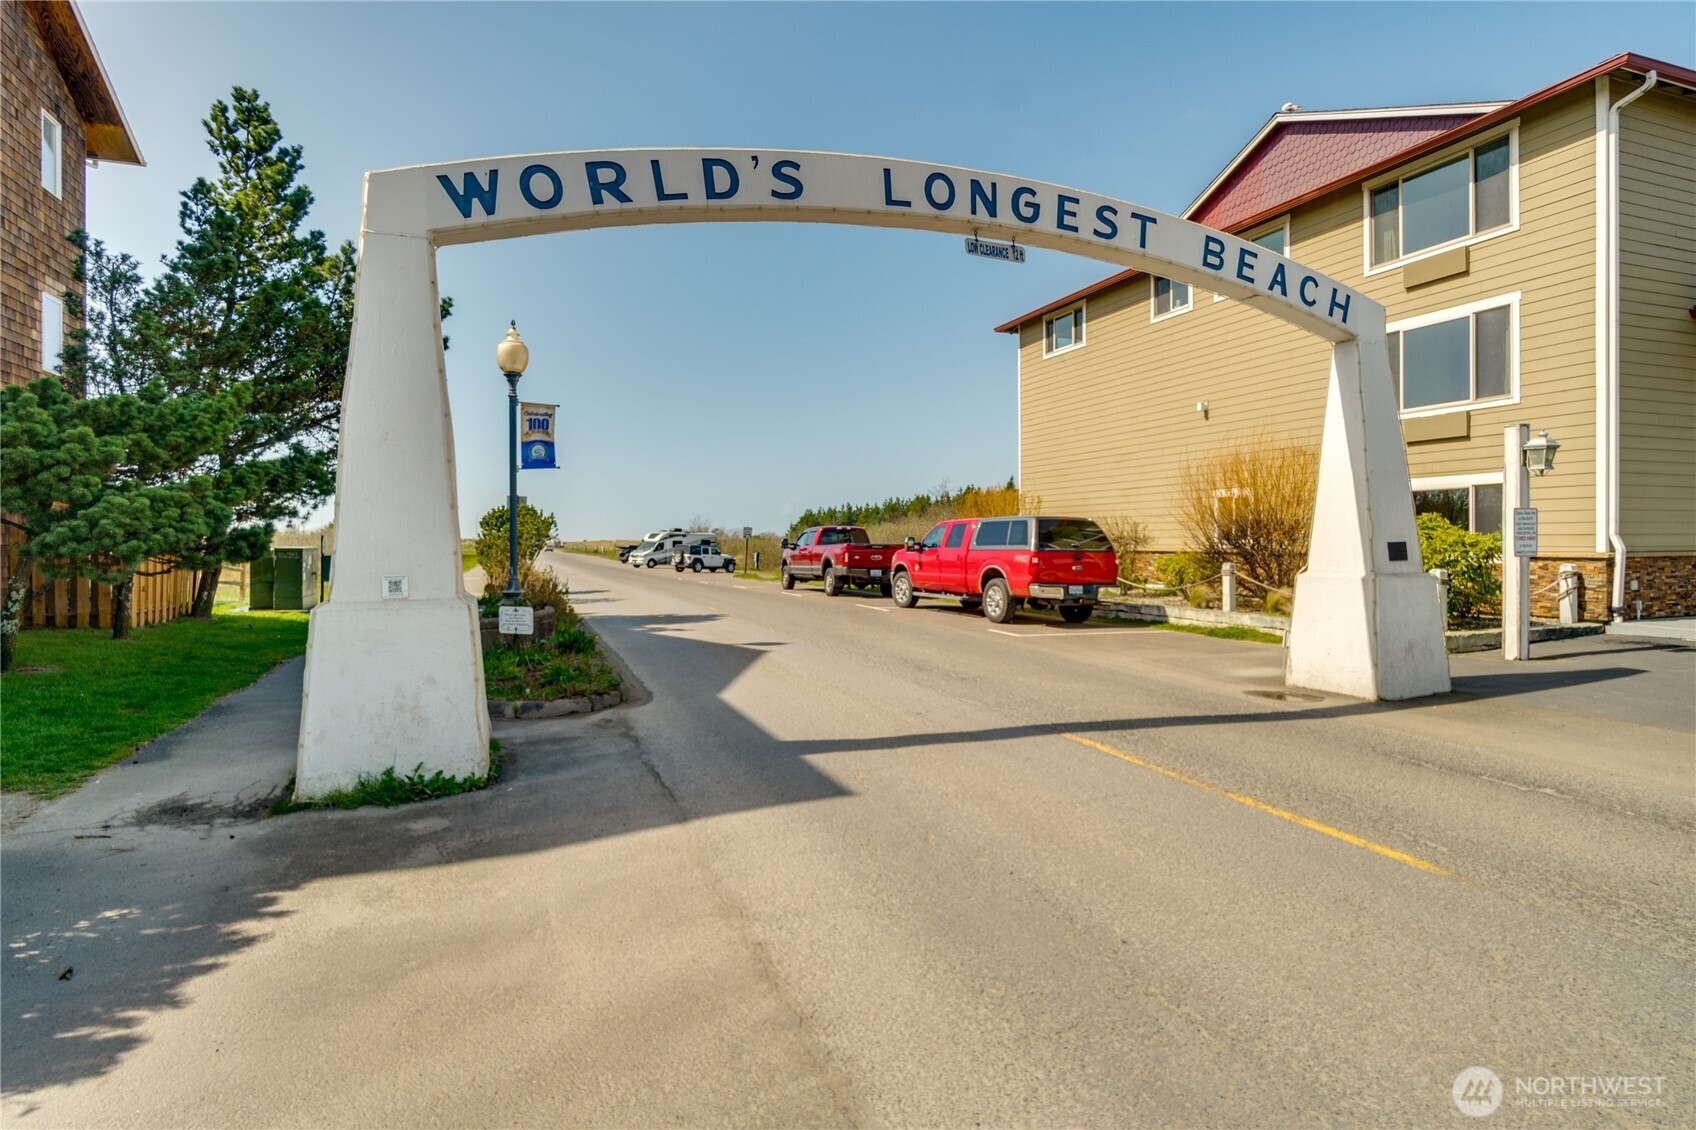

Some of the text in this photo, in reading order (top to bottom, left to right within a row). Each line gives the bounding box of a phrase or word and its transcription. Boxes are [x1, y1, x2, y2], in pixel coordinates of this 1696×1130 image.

[436, 155, 1352, 324] WORLD'S LONGEST BEACH
[967, 241, 979, 254] LOW
[979, 243, 1010, 259] CLEARANCE
[526, 417, 550, 431] 100
